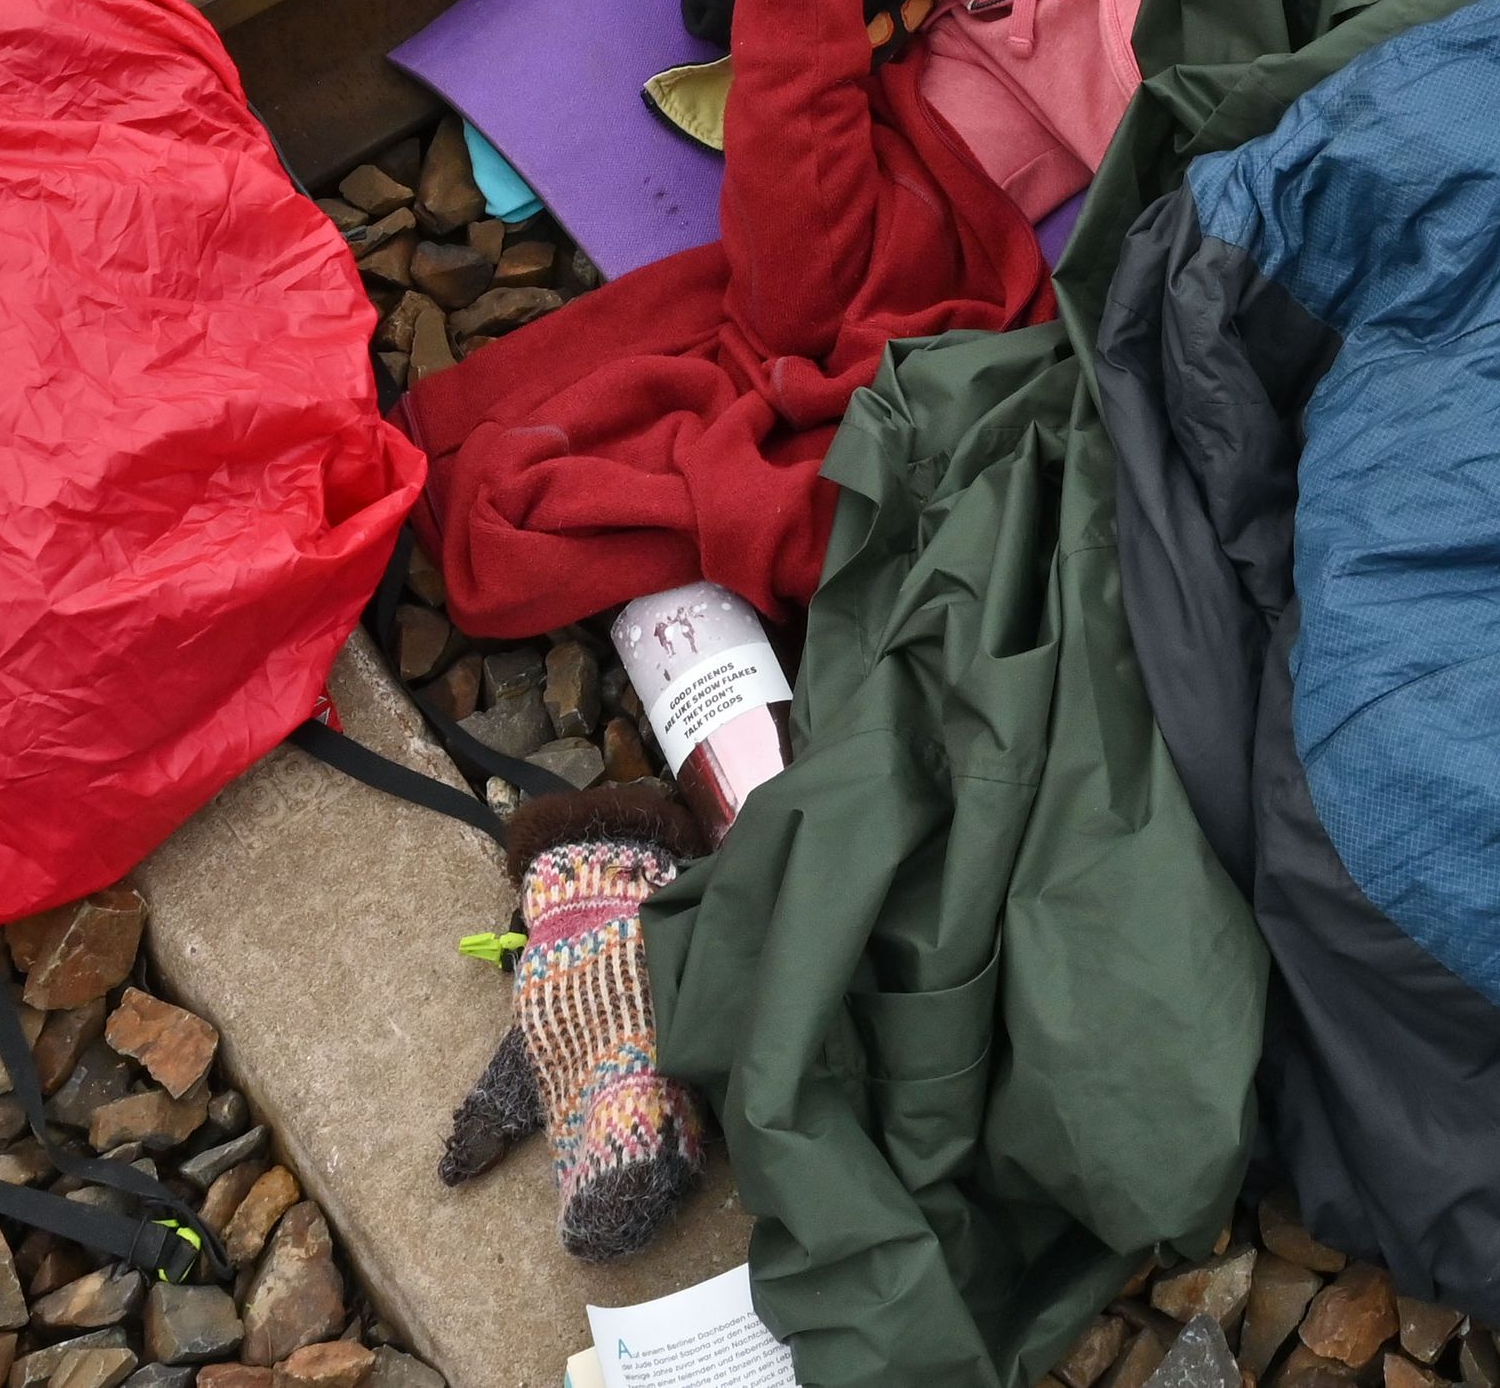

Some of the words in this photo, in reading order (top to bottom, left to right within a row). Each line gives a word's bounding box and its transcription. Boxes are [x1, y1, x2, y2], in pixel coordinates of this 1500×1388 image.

[665, 716, 676, 734] ARE
[675, 700, 692, 719] LIKE
[692, 681, 720, 704] SNOW
[722, 666, 757, 685] FLAKES
[669, 687, 692, 710] GOOD
[692, 662, 734, 690] FRIENDS
[682, 704, 703, 725] THEY
[704, 685, 734, 708] DON'T
[684, 719, 703, 739] TALK
[703, 709, 716, 721] TO
[717, 694, 743, 713] COPS
[697, 1315, 746, 1340] Dachboden
[727, 1328, 743, 1340] den
[744, 1320, 761, 1331] Naz
[731, 1328, 768, 1349] Nachtclu
[718, 1355, 734, 1367] und
[735, 1336, 774, 1359] fiebernde
[762, 1345, 784, 1358] Sam
[775, 1352, 791, 1364] Leb
